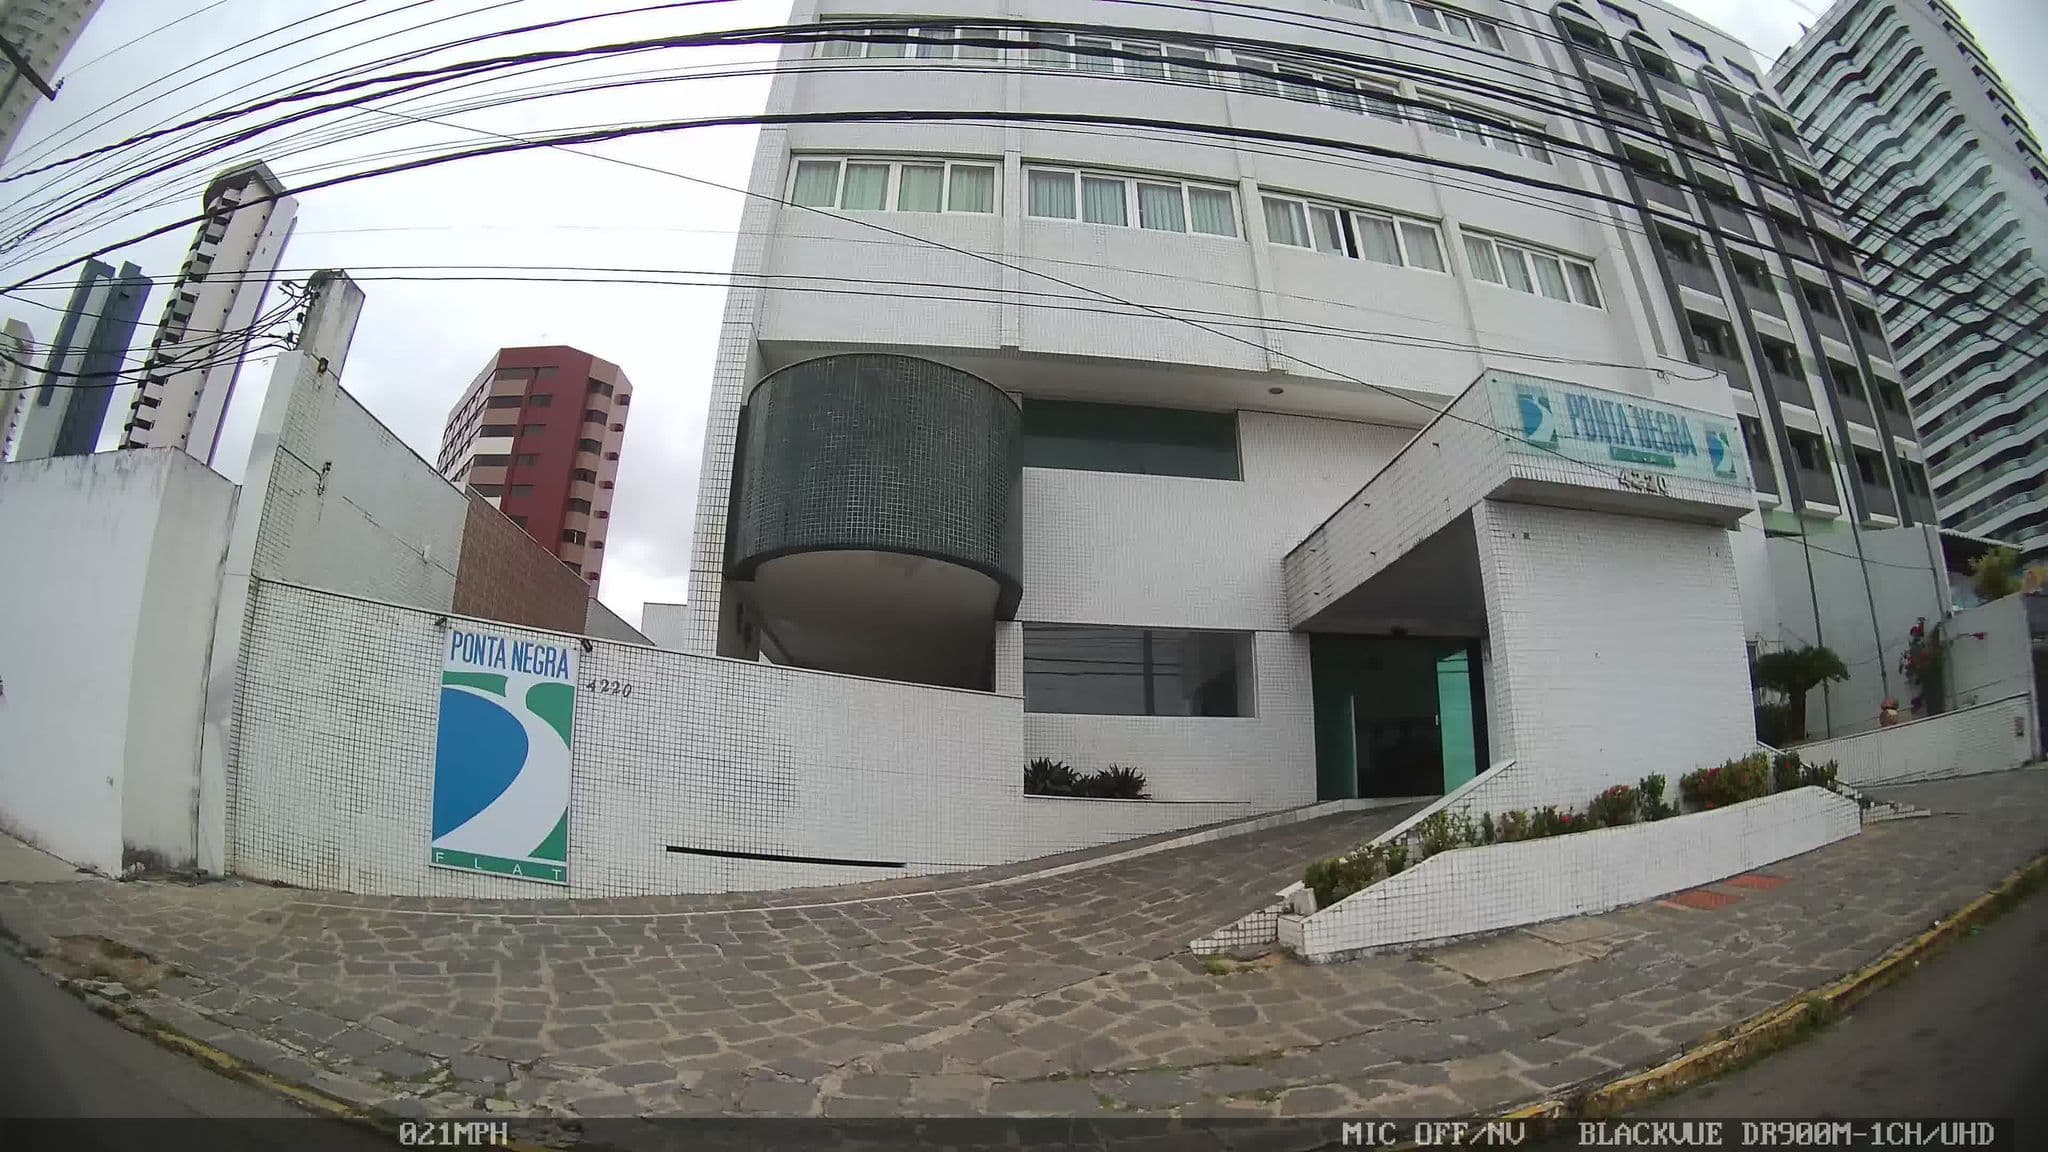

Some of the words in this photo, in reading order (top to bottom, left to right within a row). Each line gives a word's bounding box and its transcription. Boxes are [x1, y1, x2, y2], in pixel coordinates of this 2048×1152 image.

[1565, 393, 1636, 447] PONTA
[1631, 406, 1698, 457] NEGRA
[1618, 469, 1667, 495] 4220
[451, 630, 506, 669] PONTA
[511, 638, 569, 679] NEGRA
[586, 678, 632, 698] 4220
[435, 852, 562, 880] FLAT
